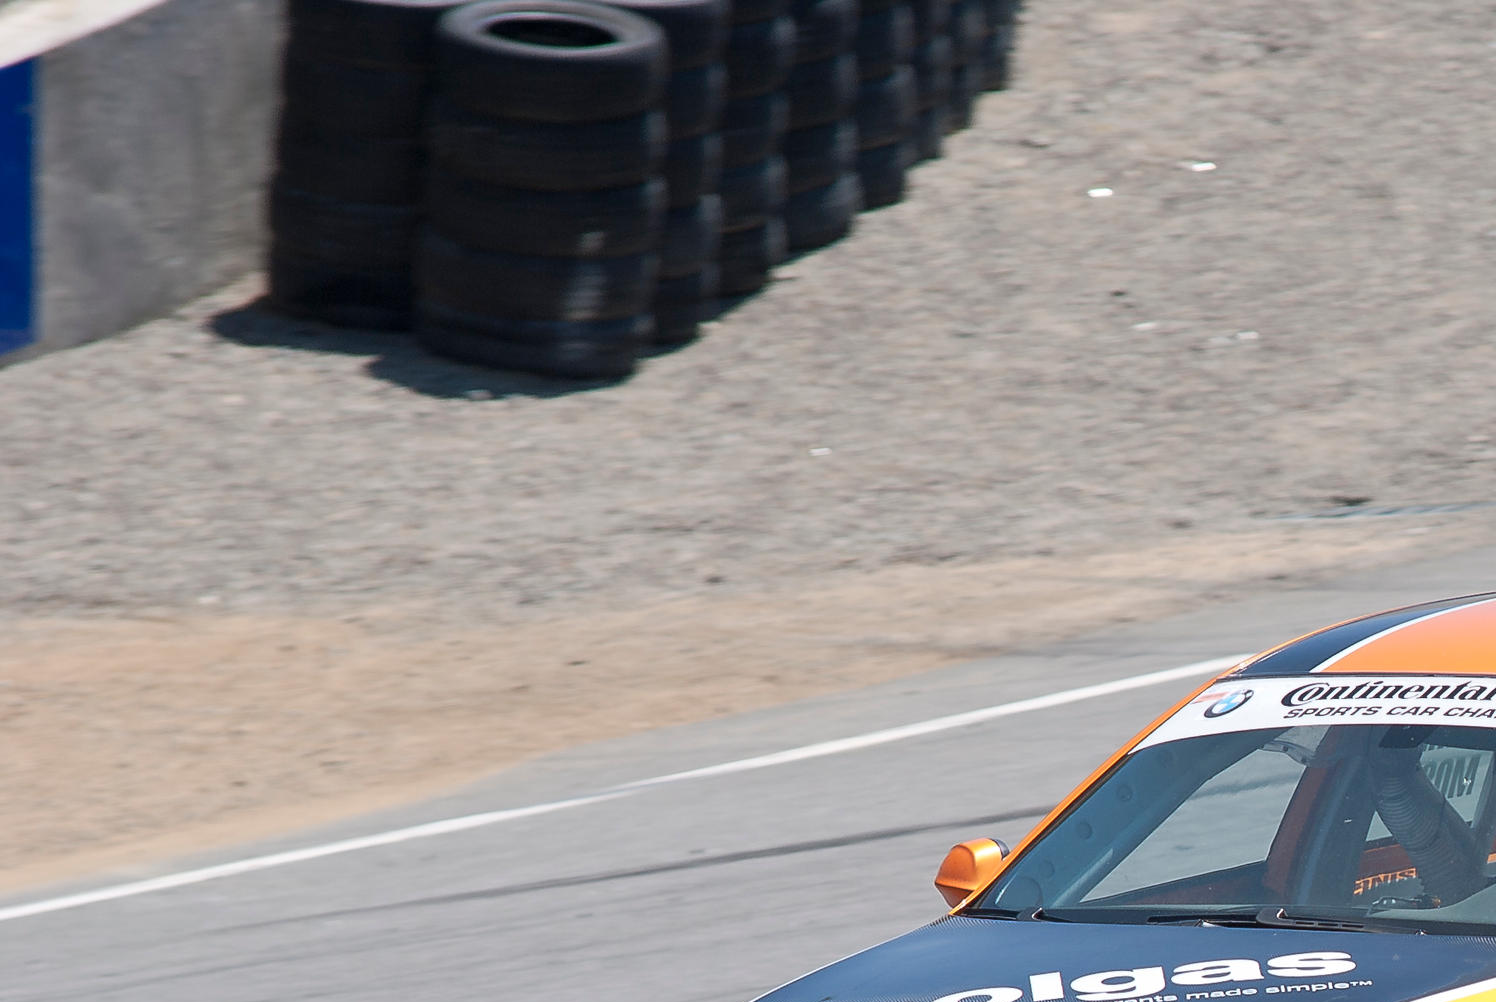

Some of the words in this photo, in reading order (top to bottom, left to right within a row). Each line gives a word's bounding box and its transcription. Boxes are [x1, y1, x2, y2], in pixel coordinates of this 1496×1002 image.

[1283, 706, 1382, 719] SPORTS
[1386, 706, 1441, 717] CAR
[1186, 985, 1258, 1001] made
